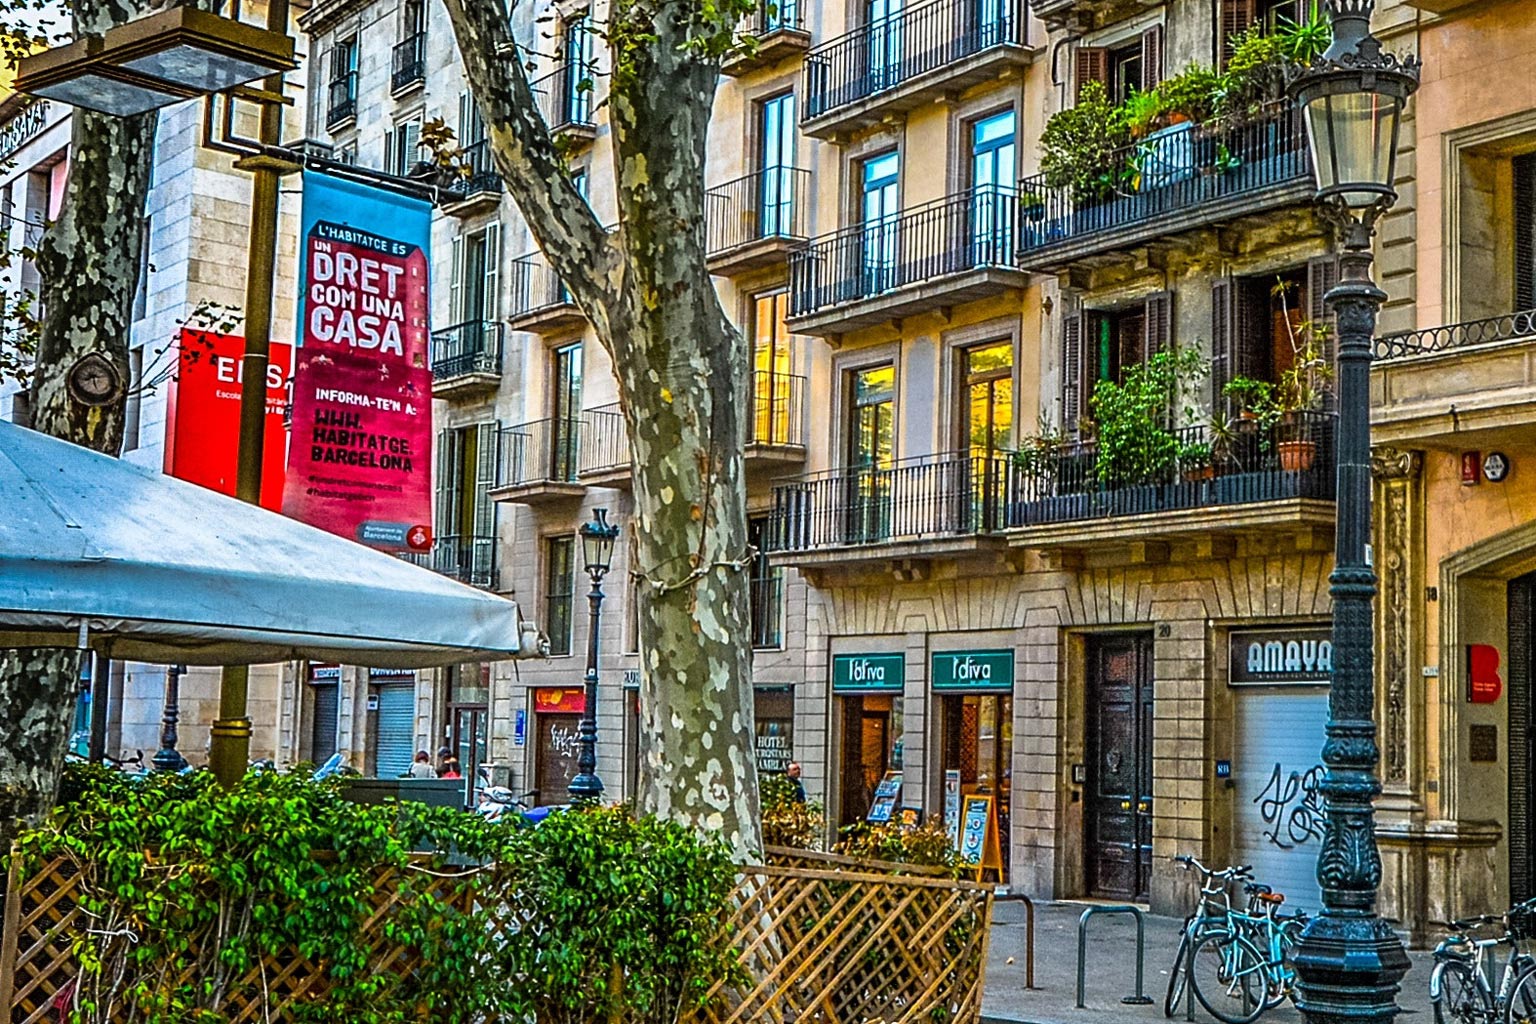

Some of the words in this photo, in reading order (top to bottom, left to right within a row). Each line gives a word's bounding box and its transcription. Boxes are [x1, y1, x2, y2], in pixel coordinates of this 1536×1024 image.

[314, 240, 331, 253] UN
[392, 243, 406, 255] ÉS
[313, 251, 404, 298] DRET
[311, 283, 356, 310] COM
[362, 294, 404, 321] UNA
[310, 305, 403, 356] CASA
[315, 387, 401, 412] INFORMA-TE'N
[405, 402, 417, 415] A:
[314, 409, 363, 429] WWW.
[312, 427, 414, 455] HABITATGE.
[311, 446, 412, 473] BARCELONA
[364, 531, 401, 541] Barcelona
[1159, 624, 1171, 638] 20
[1248, 639, 1333, 673] AMAYA
[755, 748, 793, 758] UROSTARS
[757, 735, 788, 748] HOTEL
